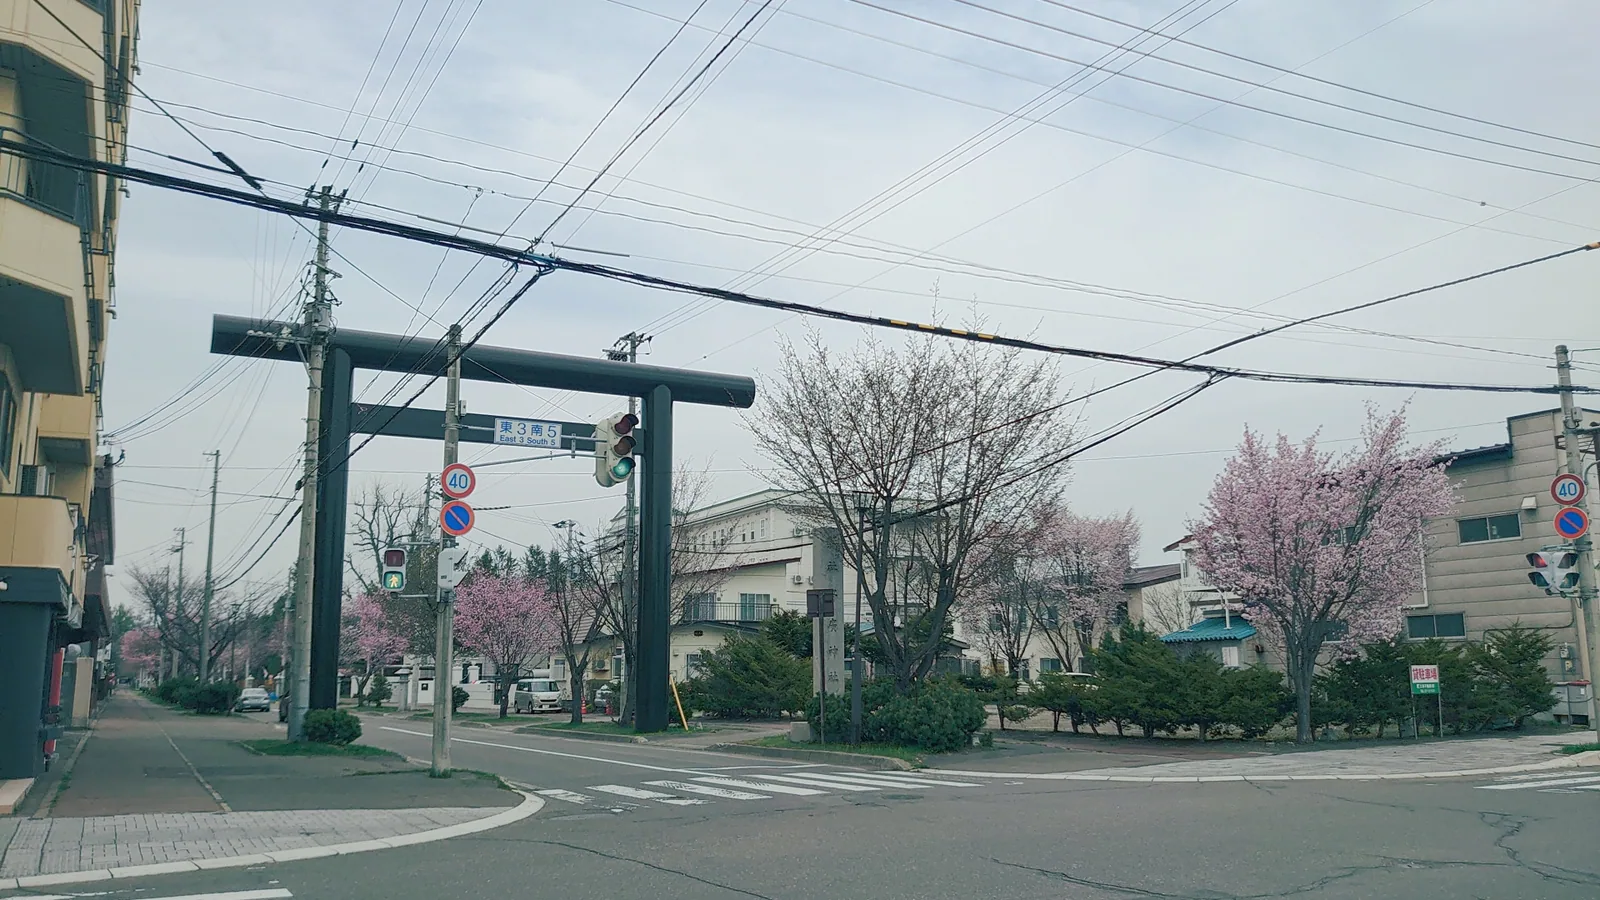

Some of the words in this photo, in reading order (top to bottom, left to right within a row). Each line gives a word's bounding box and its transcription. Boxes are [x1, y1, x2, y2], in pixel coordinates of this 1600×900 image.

[499, 420, 557, 439] 東3南5
[499, 434, 517, 443] East
[518, 436, 525, 444] 3
[526, 436, 549, 445] South
[448, 472, 469, 490] 40
[1558, 482, 1578, 497] 40
